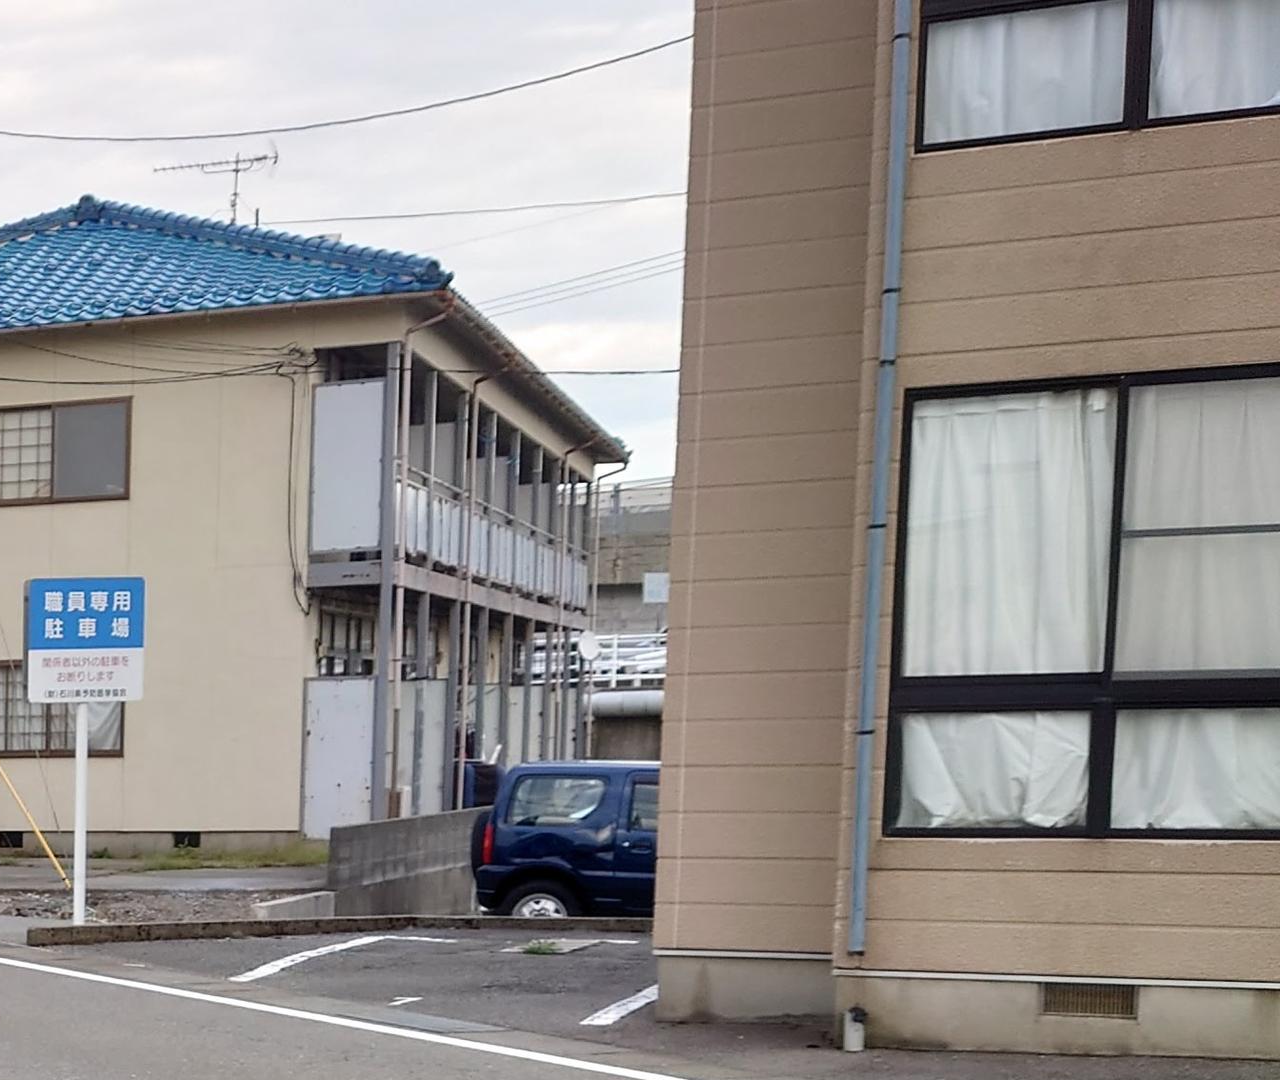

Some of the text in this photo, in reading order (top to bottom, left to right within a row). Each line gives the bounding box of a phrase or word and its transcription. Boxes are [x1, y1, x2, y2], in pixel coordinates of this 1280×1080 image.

[44, 591, 131, 612] 職員専用
[44, 618, 130, 639] 駐車場
